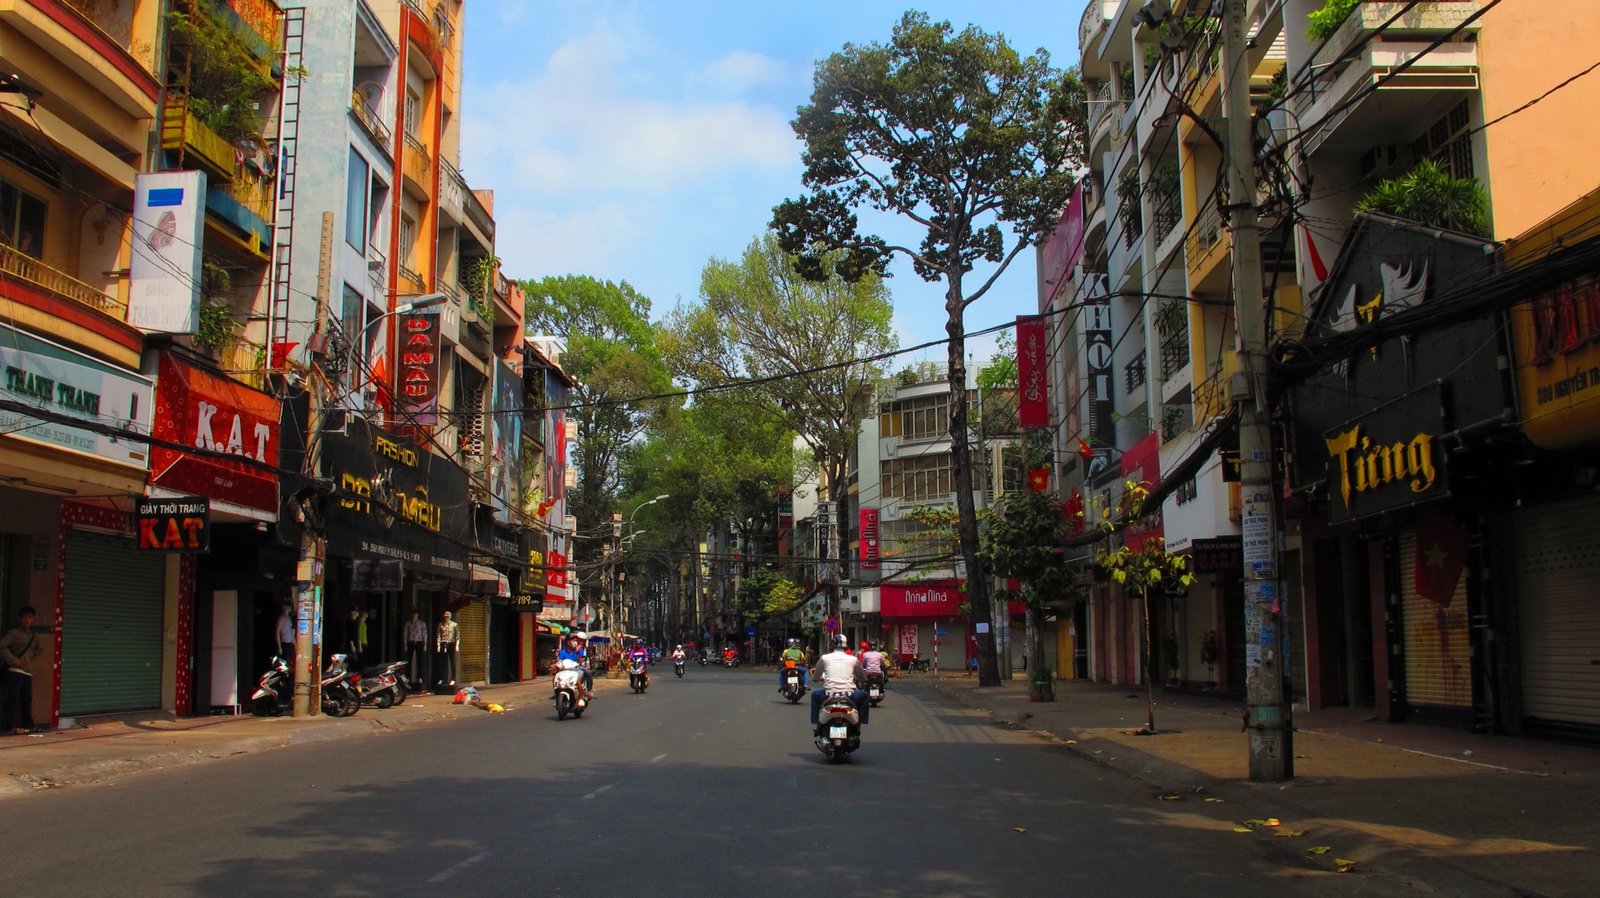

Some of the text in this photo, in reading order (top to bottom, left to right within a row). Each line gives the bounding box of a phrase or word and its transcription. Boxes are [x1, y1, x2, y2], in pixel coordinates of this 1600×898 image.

[376, 436, 419, 468] FASHION
[178, 503, 207, 514] TRANG
[138, 516, 204, 550] KAT
